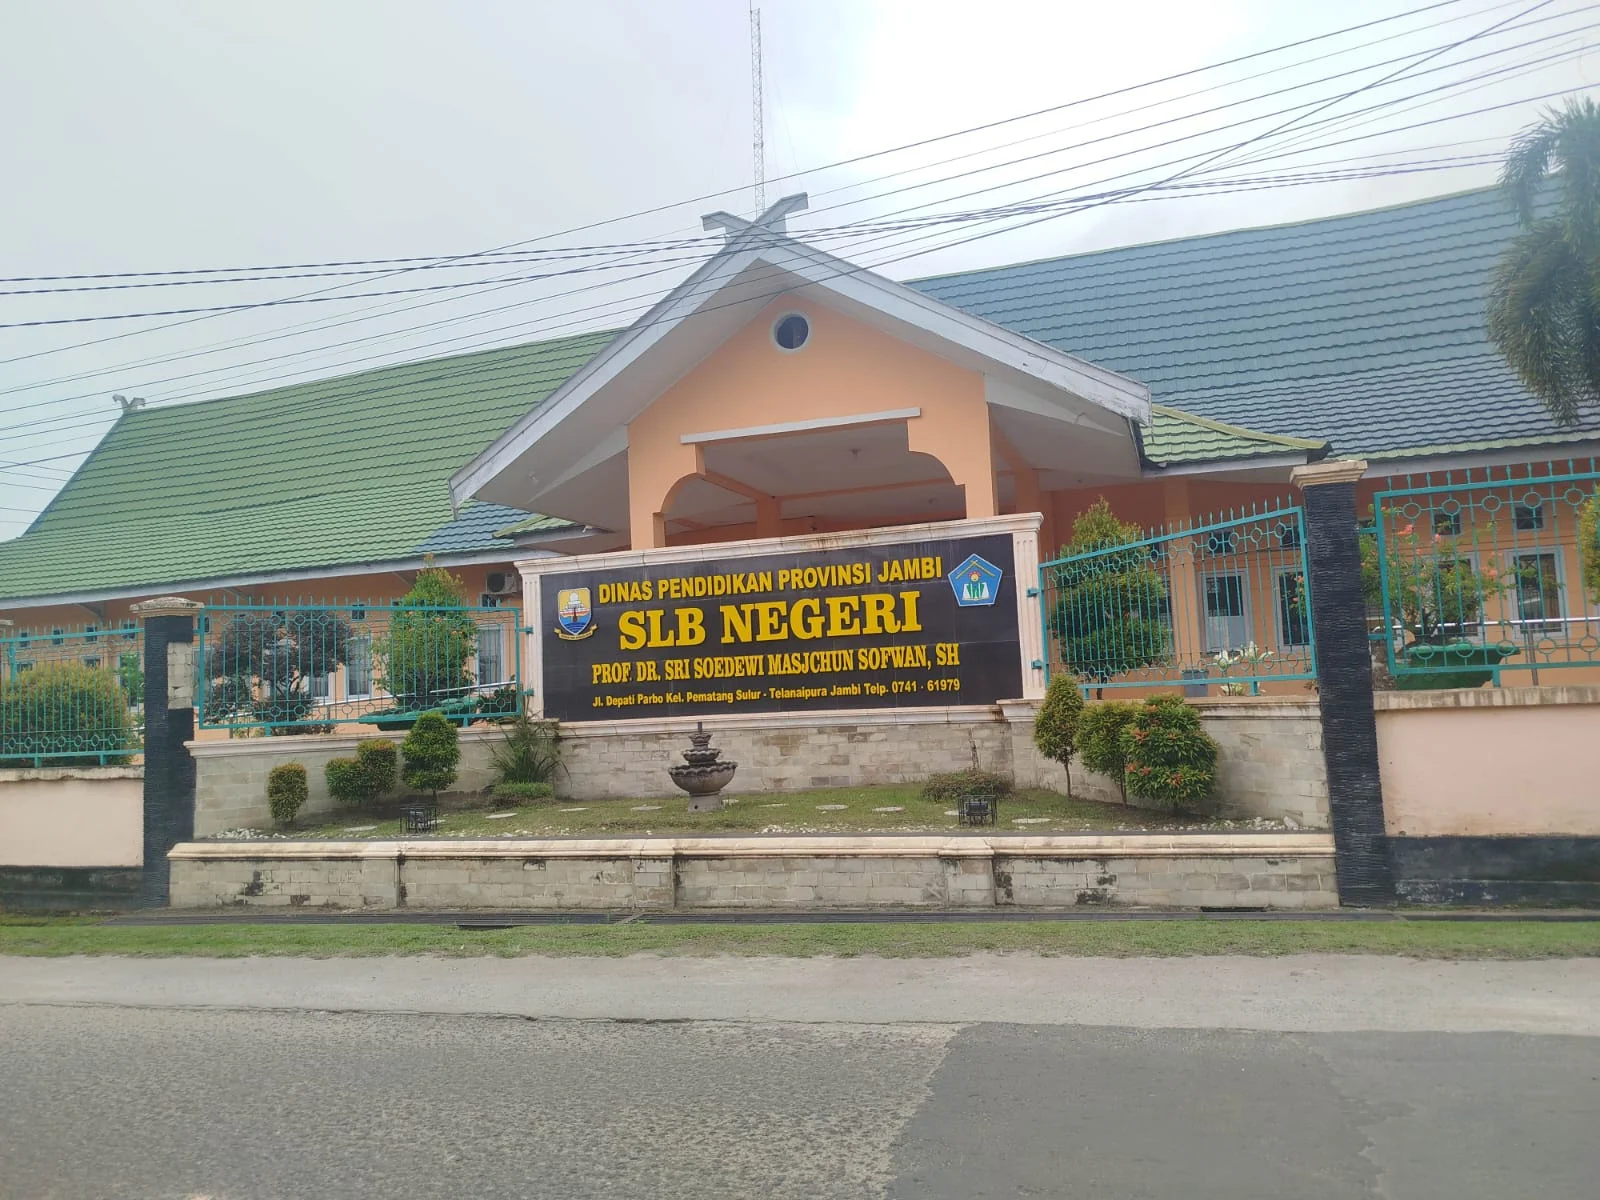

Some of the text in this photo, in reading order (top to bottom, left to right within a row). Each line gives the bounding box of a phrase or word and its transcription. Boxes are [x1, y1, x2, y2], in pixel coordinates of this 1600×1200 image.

[599, 556, 942, 604] DINAS PENDIDIKAN PROVINSI JAMBI
[618, 591, 922, 650] SLB NEGERI
[636, 660, 661, 682] DR.
[665, 658, 690, 680] SRI
[694, 655, 764, 679] SOEDEWI
[768, 649, 854, 676] MASJCHUN
[857, 644, 932, 671] SOFWAN,
[935, 642, 960, 667] SH
[606, 693, 635, 708] Depati
[637, 693, 663, 705] Parbo
[665, 692, 684, 703] Kel.
[686, 690, 734, 704] Pematang
[736, 688, 760, 701] Sulur
[769, 686, 827, 700] Telanaipura
[830, 683, 861, 697] Jambi
[864, 682, 888, 697] Telp.
[891, 680, 917, 693] 0741
[927, 678, 960, 692] 61979
